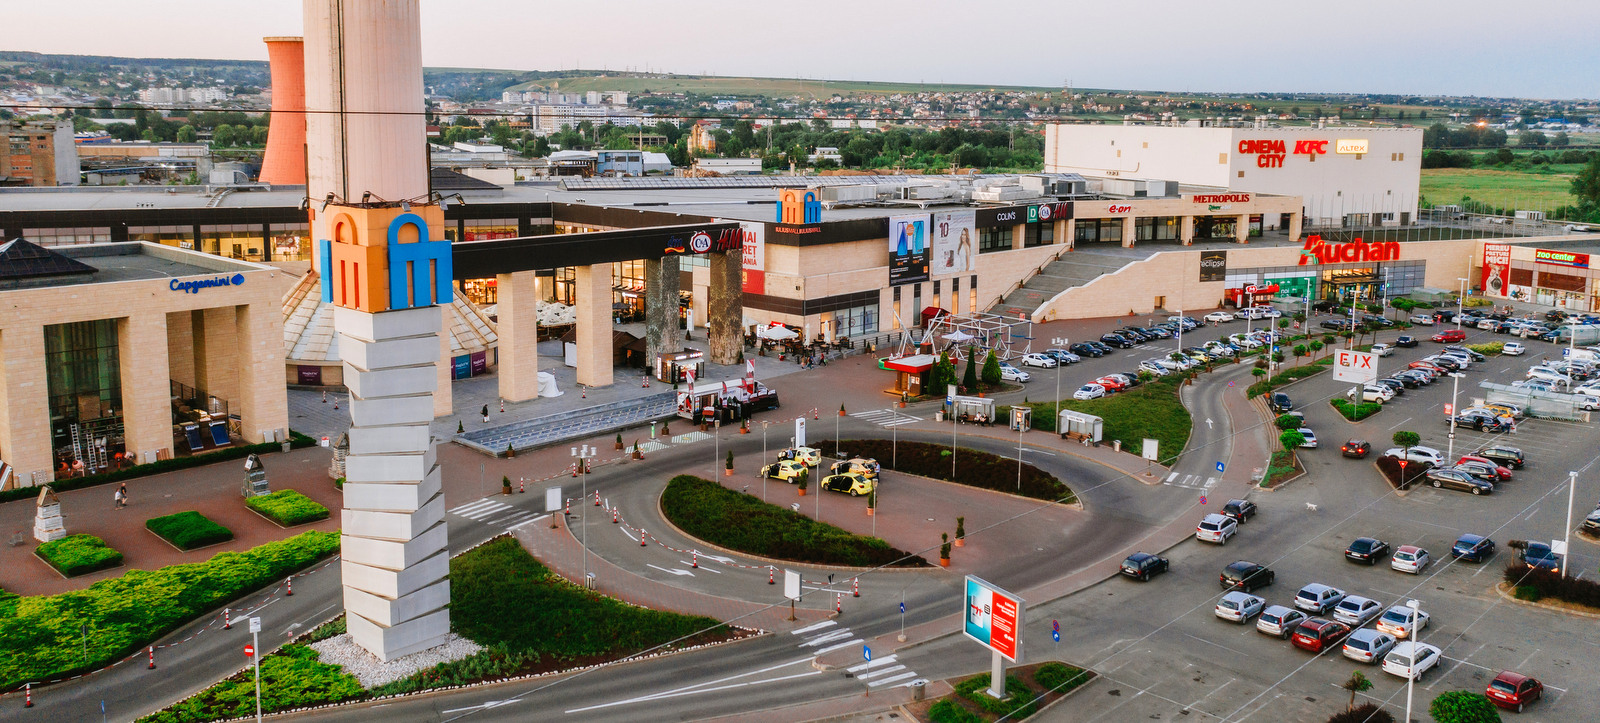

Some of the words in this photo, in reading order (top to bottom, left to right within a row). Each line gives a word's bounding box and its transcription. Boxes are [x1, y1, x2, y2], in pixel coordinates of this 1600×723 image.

[1238, 139, 1286, 154] CINEMA
[1293, 140, 1329, 154] KFC
[1257, 154, 1286, 168] CITY
[1193, 194, 1250, 204] METROPOLIS
[939, 222, 949, 238] 10
[1298, 234, 1400, 266] Auchan
[1536, 251, 1551, 259] zoo
[1551, 253, 1576, 262] center
[1200, 260, 1225, 268] eclipse
[169, 276, 231, 294] Capgemini
